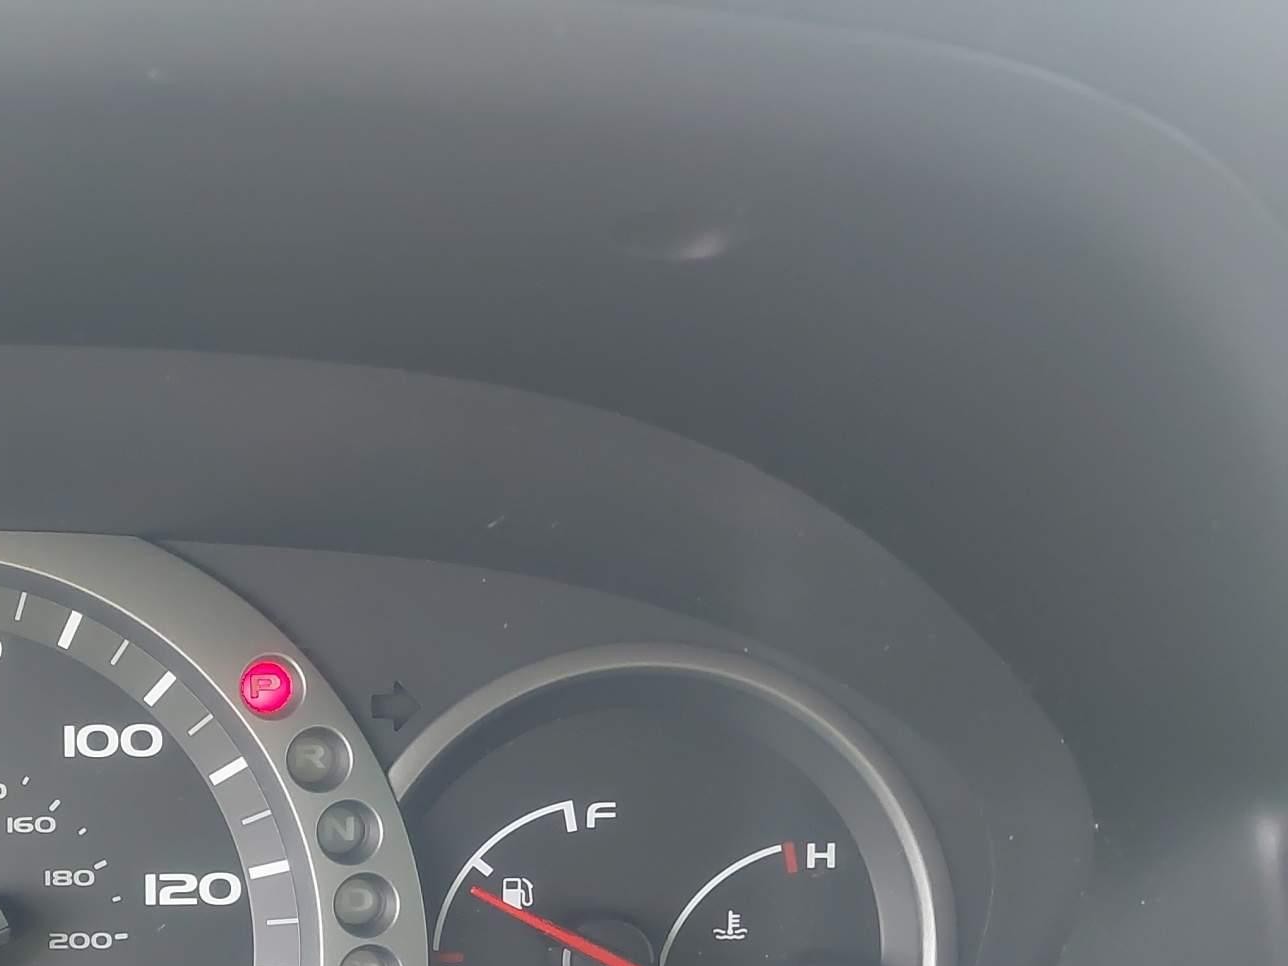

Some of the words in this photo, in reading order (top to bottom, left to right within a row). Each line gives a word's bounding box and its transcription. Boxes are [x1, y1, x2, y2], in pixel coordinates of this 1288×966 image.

[249, 674, 282, 698] P
[63, 723, 163, 758] 100
[296, 743, 326, 770] R
[7, 816, 56, 833] 160
[586, 801, 617, 829] F
[324, 820, 355, 842] N
[806, 843, 836, 869] H
[44, 869, 95, 887] 180
[145, 872, 242, 906] 120
[345, 890, 373, 912] D
[48, 933, 113, 949] 200
